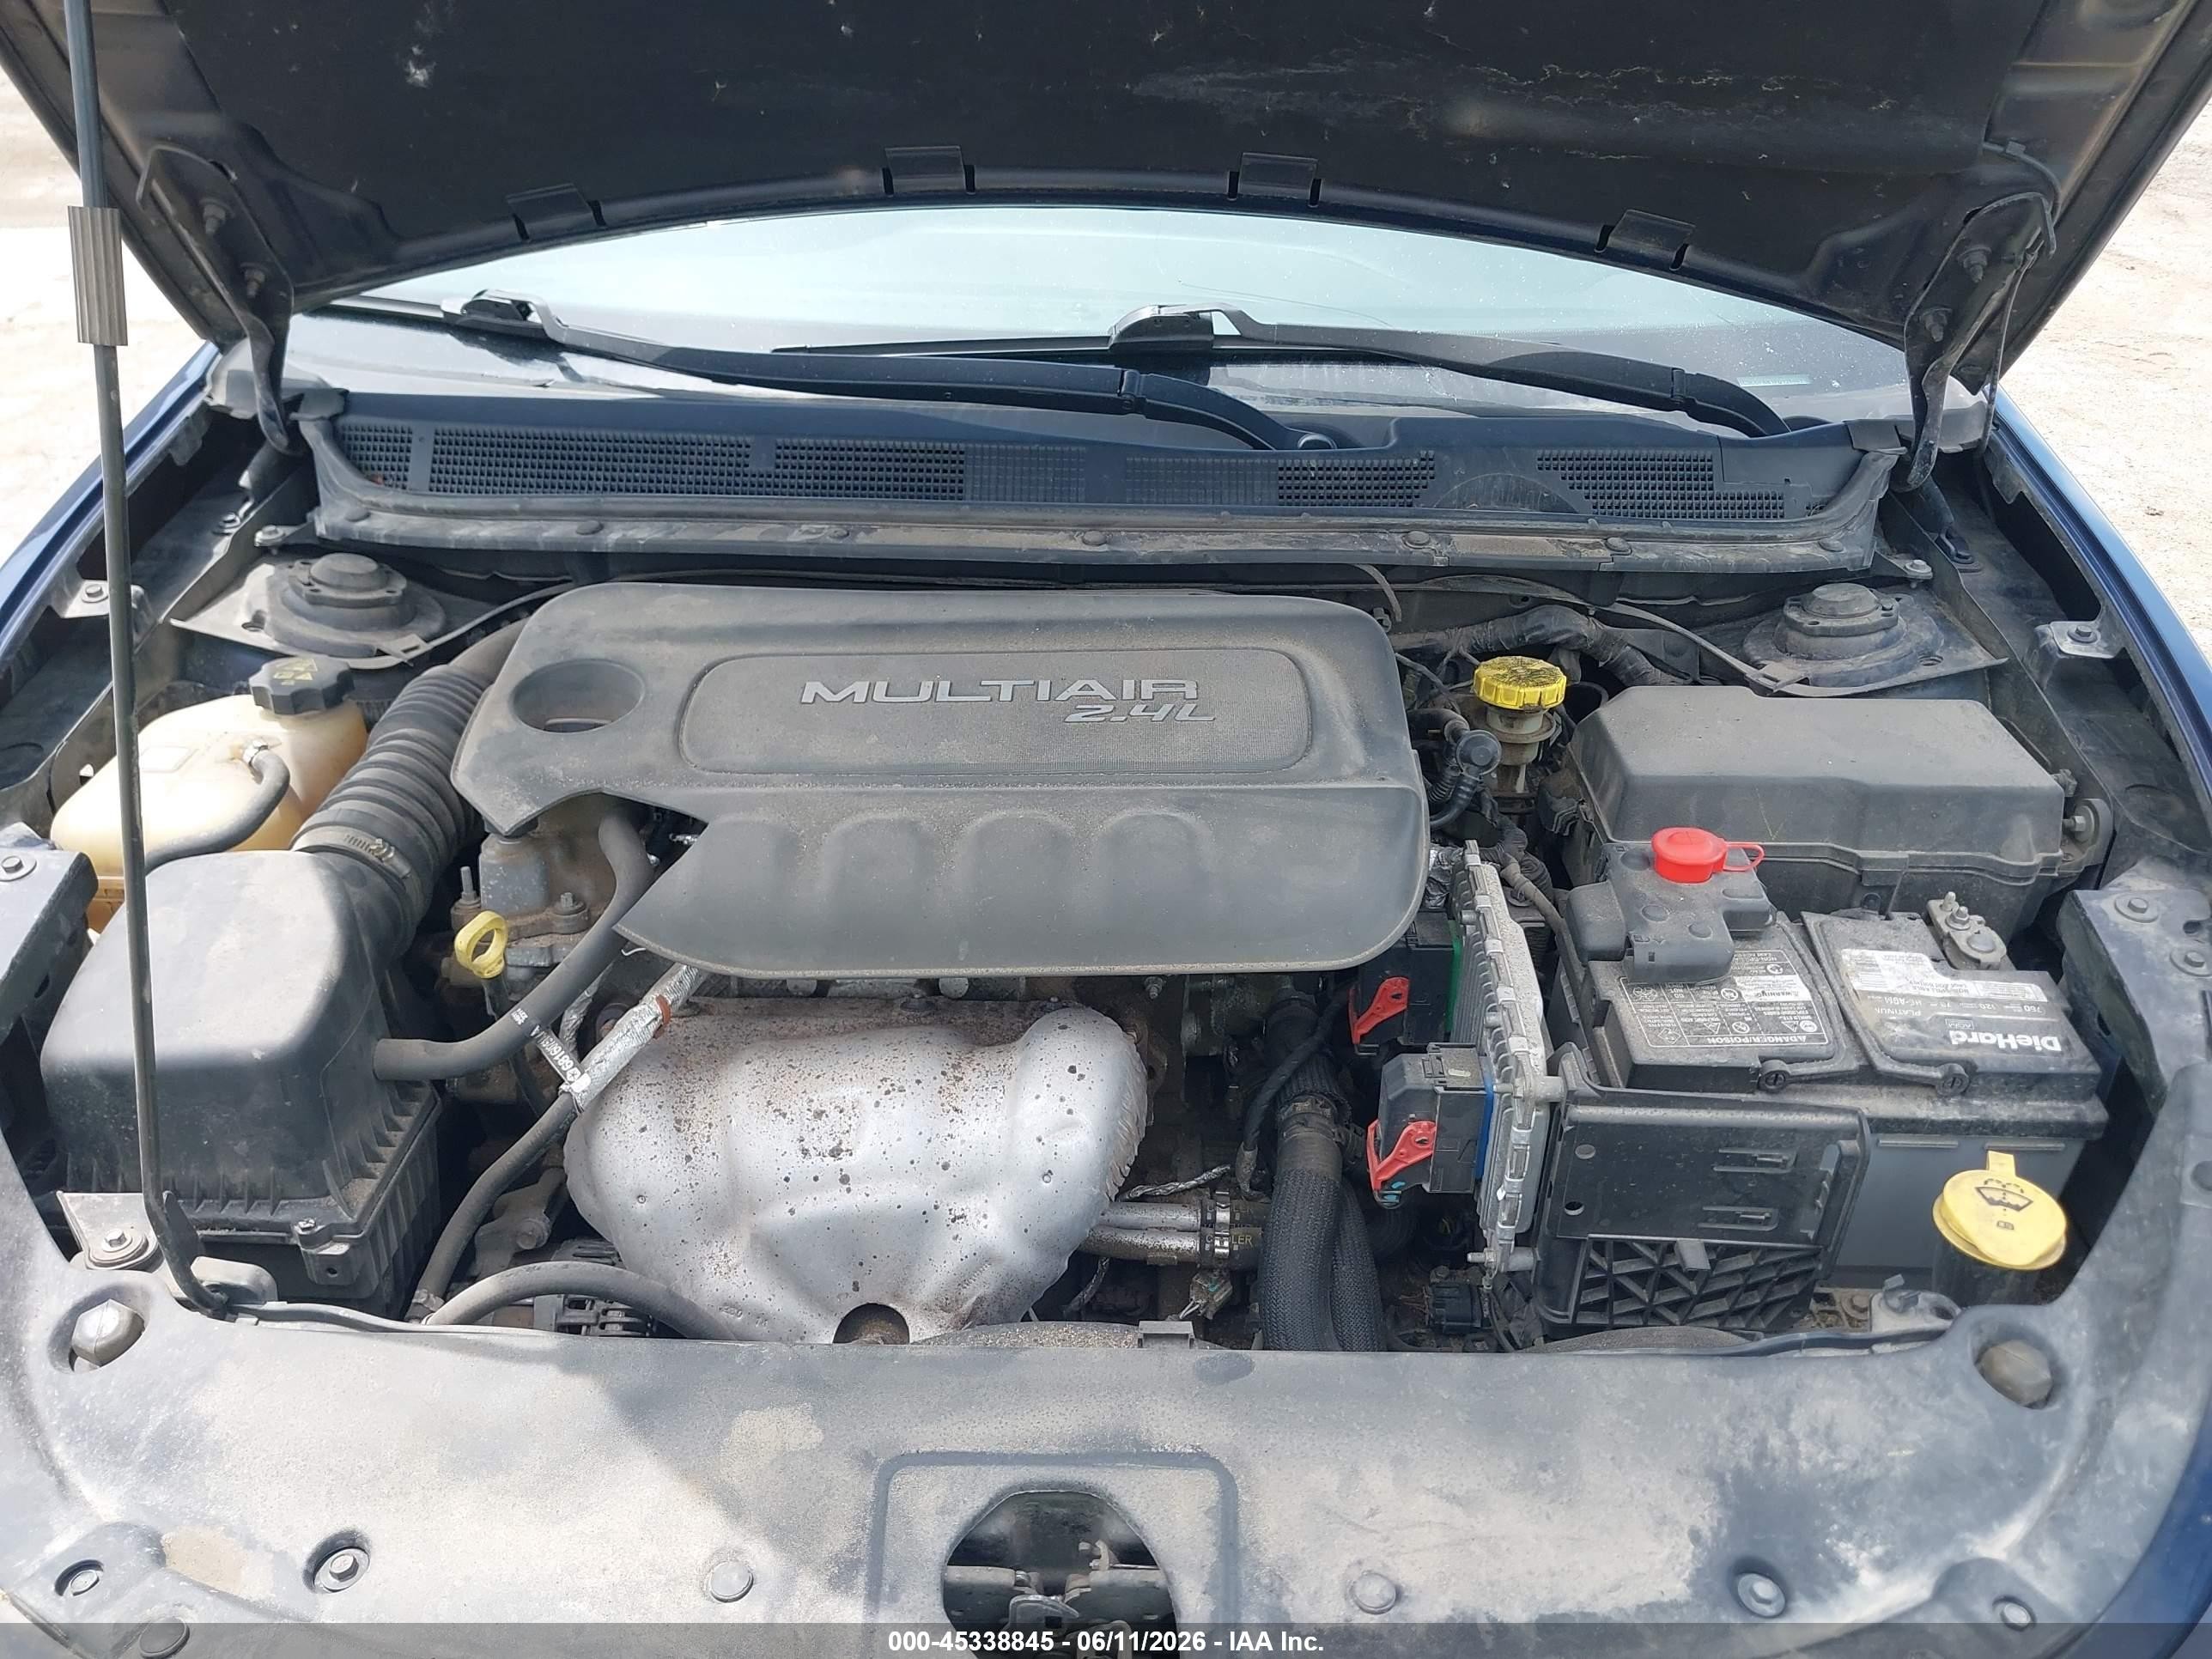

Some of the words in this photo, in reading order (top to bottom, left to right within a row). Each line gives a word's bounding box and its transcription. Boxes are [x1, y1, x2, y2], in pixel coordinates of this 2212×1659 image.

[799, 679, 1199, 703] MULTIAIR
[1064, 702, 1217, 723] 2.4L
[1948, 1030, 2062, 1052] DieHard
